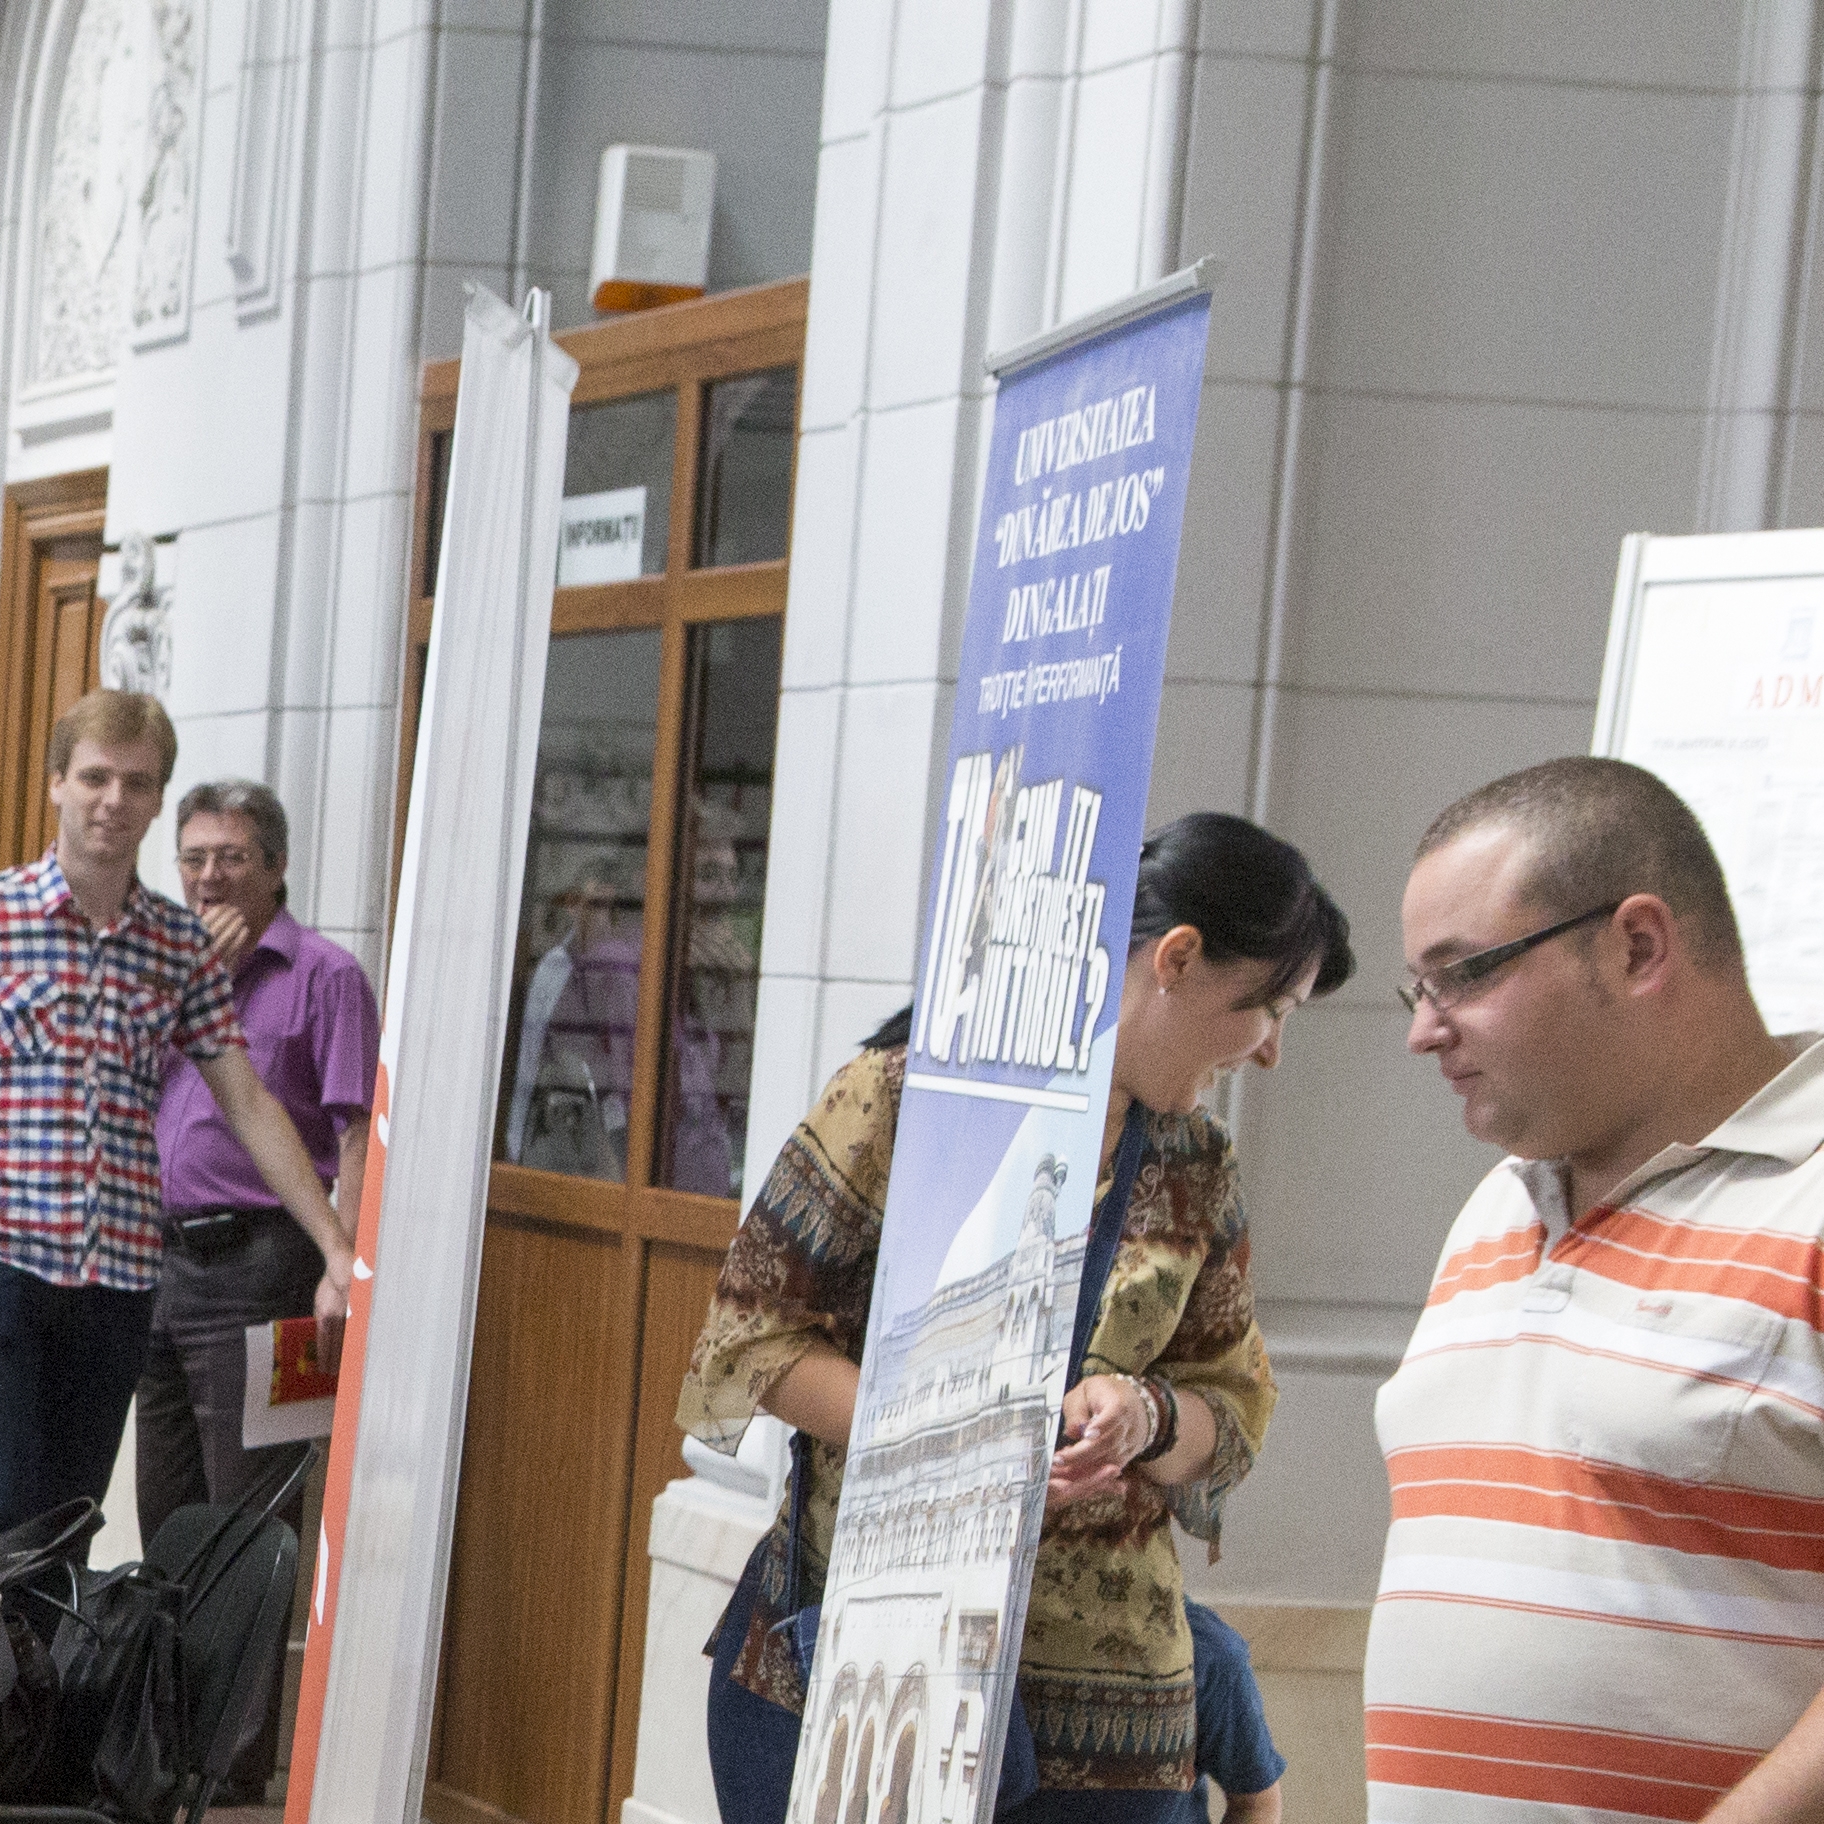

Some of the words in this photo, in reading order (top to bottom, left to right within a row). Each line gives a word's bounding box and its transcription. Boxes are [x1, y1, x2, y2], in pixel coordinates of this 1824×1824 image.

[1014, 384, 1156, 487] UNIVERSITATEA
[1081, 480, 1114, 547] DE
[1002, 583, 1047, 645] DIN
[1006, 777, 1064, 879] CUM
